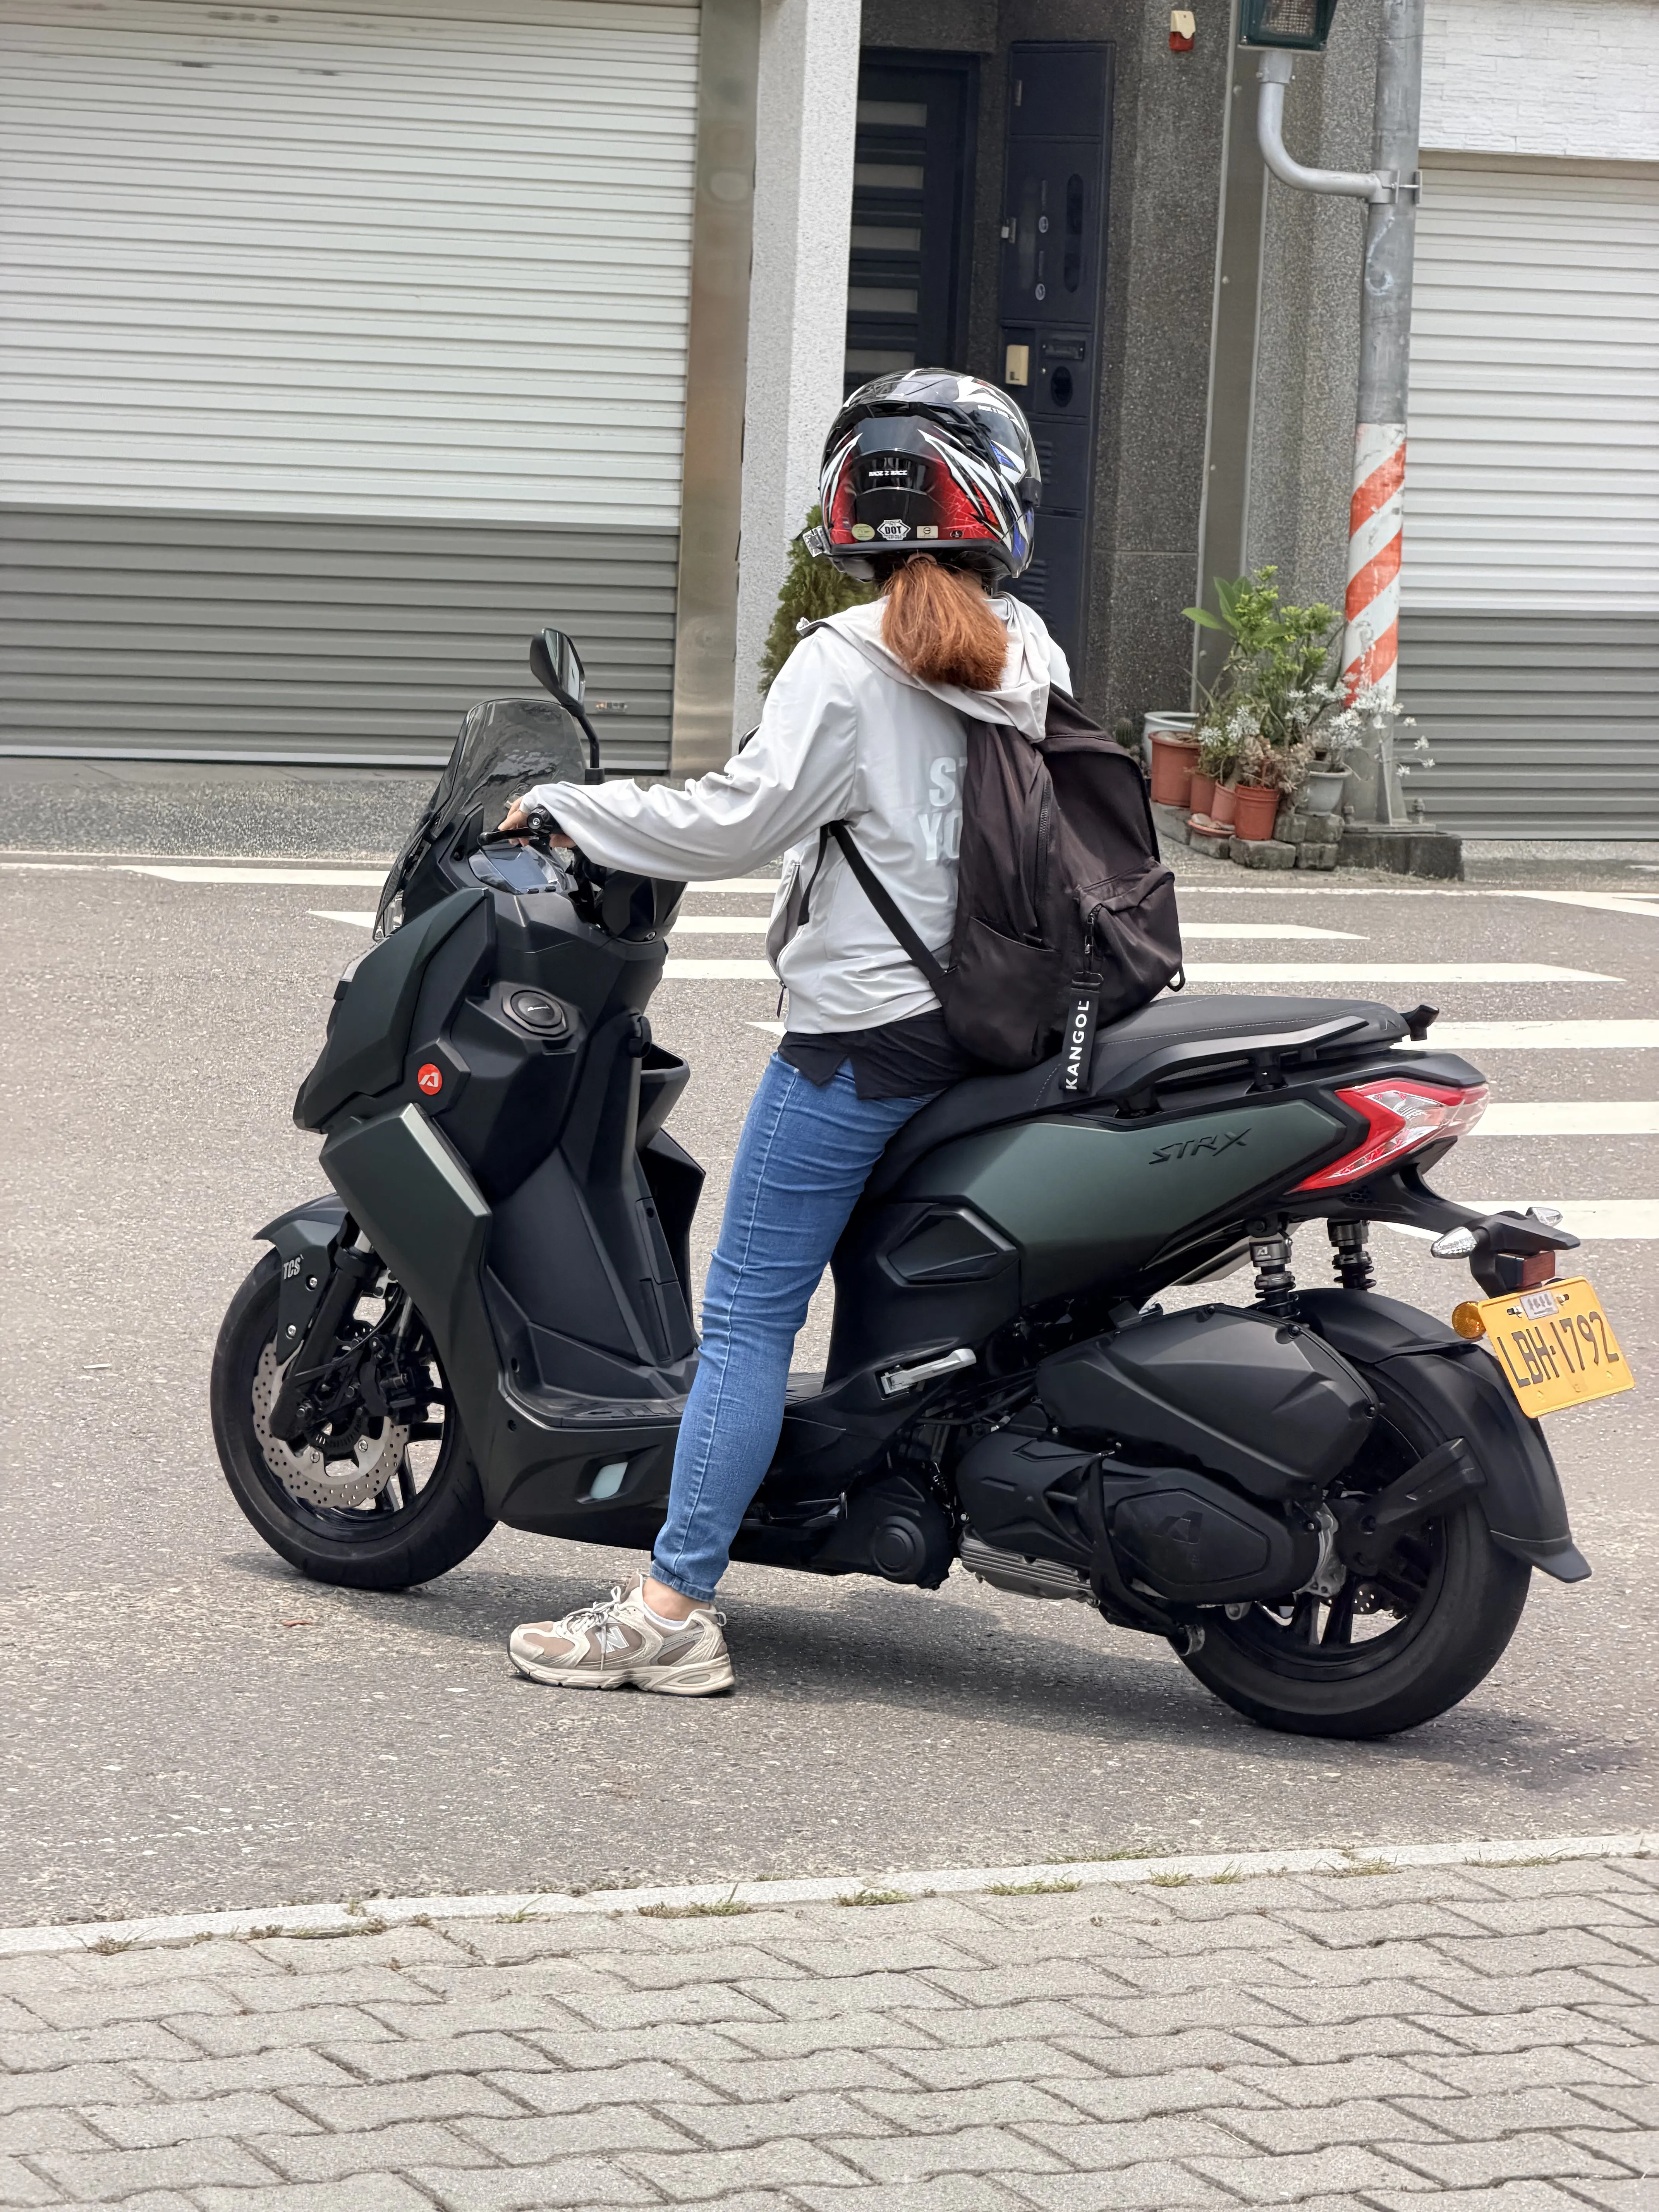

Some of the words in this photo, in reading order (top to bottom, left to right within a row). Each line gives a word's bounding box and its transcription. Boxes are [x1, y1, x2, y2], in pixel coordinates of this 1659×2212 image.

[884, 526, 902, 534] DOT
[1065, 1000, 1090, 1090] KANGOL
[1149, 1128, 1251, 1164] STRX
[283, 1257, 301, 1280] TCS
[1497, 1311, 1619, 1388] LBH-1792
